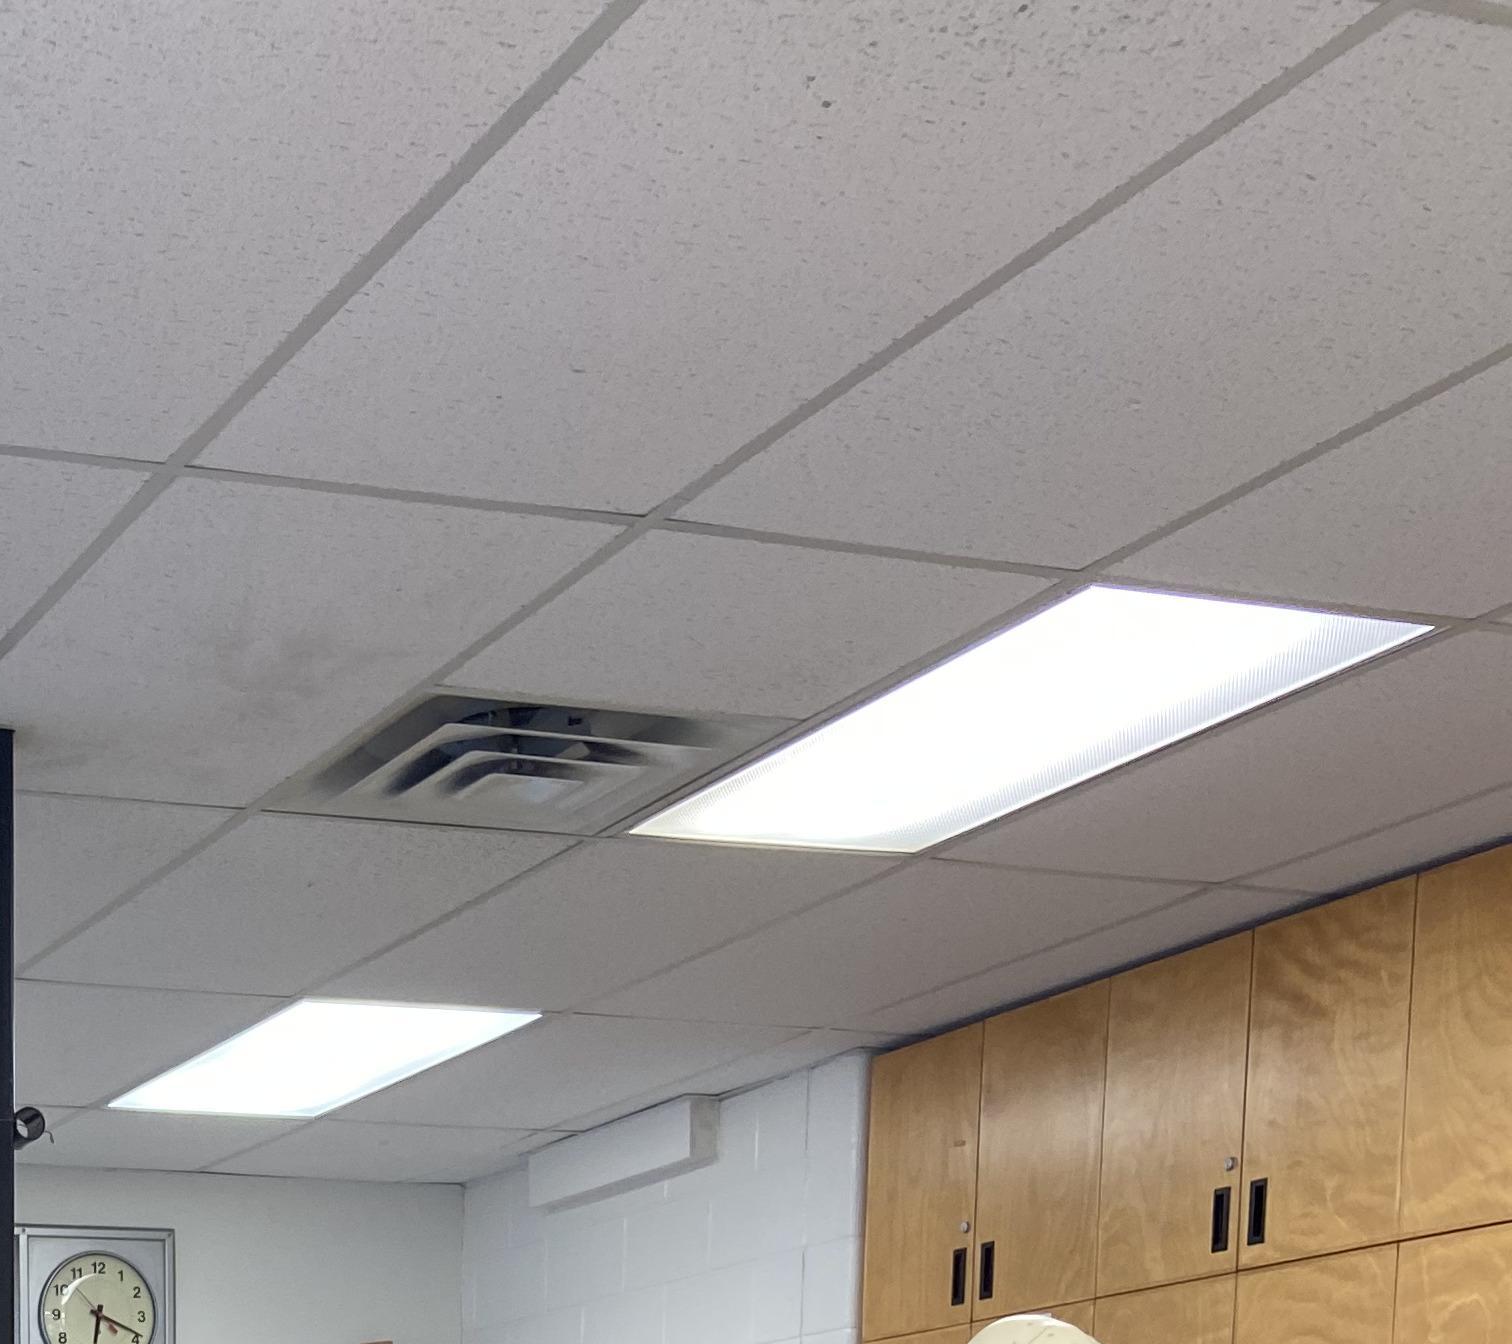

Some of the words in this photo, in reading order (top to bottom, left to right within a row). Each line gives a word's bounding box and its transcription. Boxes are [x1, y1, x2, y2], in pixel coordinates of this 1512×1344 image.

[71, 1267, 83, 1280] 11
[91, 1262, 106, 1274] 12
[118, 1270, 124, 1282] 1
[133, 1286, 141, 1299] 2
[52, 1308, 61, 1320] 9
[137, 1311, 146, 1323] 3
[58, 1332, 67, 1344] 8
[131, 1333, 140, 1344] 4
